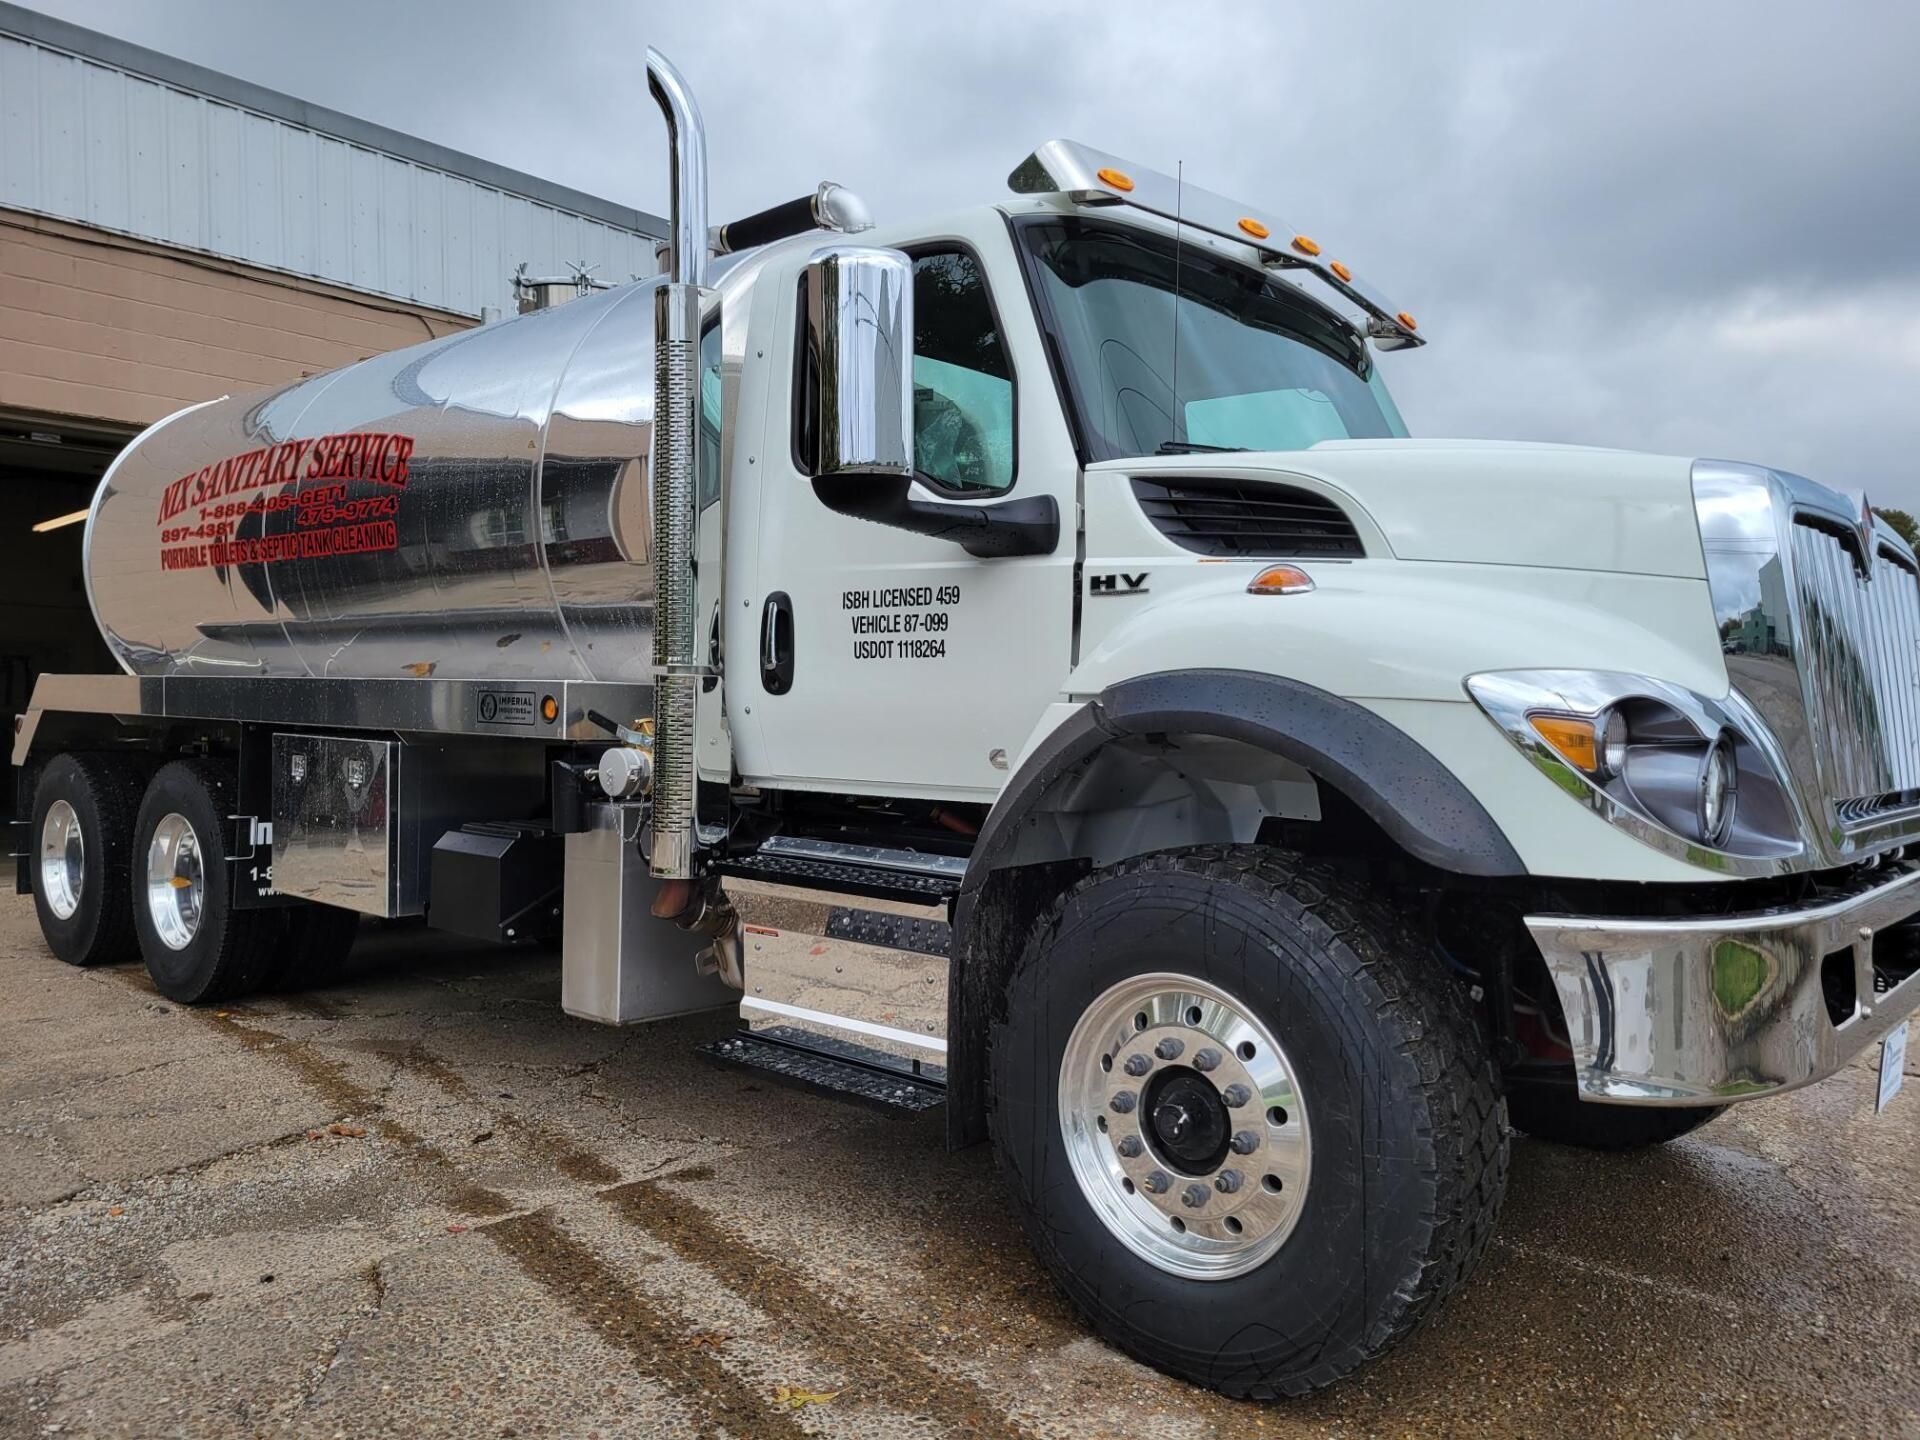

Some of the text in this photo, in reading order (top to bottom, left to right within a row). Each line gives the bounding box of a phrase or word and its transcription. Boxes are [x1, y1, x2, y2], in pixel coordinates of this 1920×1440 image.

[157, 433, 415, 526] NIX SANITARY SERVICE
[199, 482, 347, 521] 1-888-405-GET1
[161, 495, 399, 543] 897-4381 475-9774
[161, 521, 396, 571] PORTABLE TOILETS & SEPTIC TANK CLEANING
[1090, 572, 1150, 590] HV
[842, 585, 960, 610] ISBH LICENSED 459
[852, 612, 949, 634] VEHICLE 87-099
[854, 639, 946, 659] USDOT 1118264
[499, 696, 533, 706] IMPERIAL
